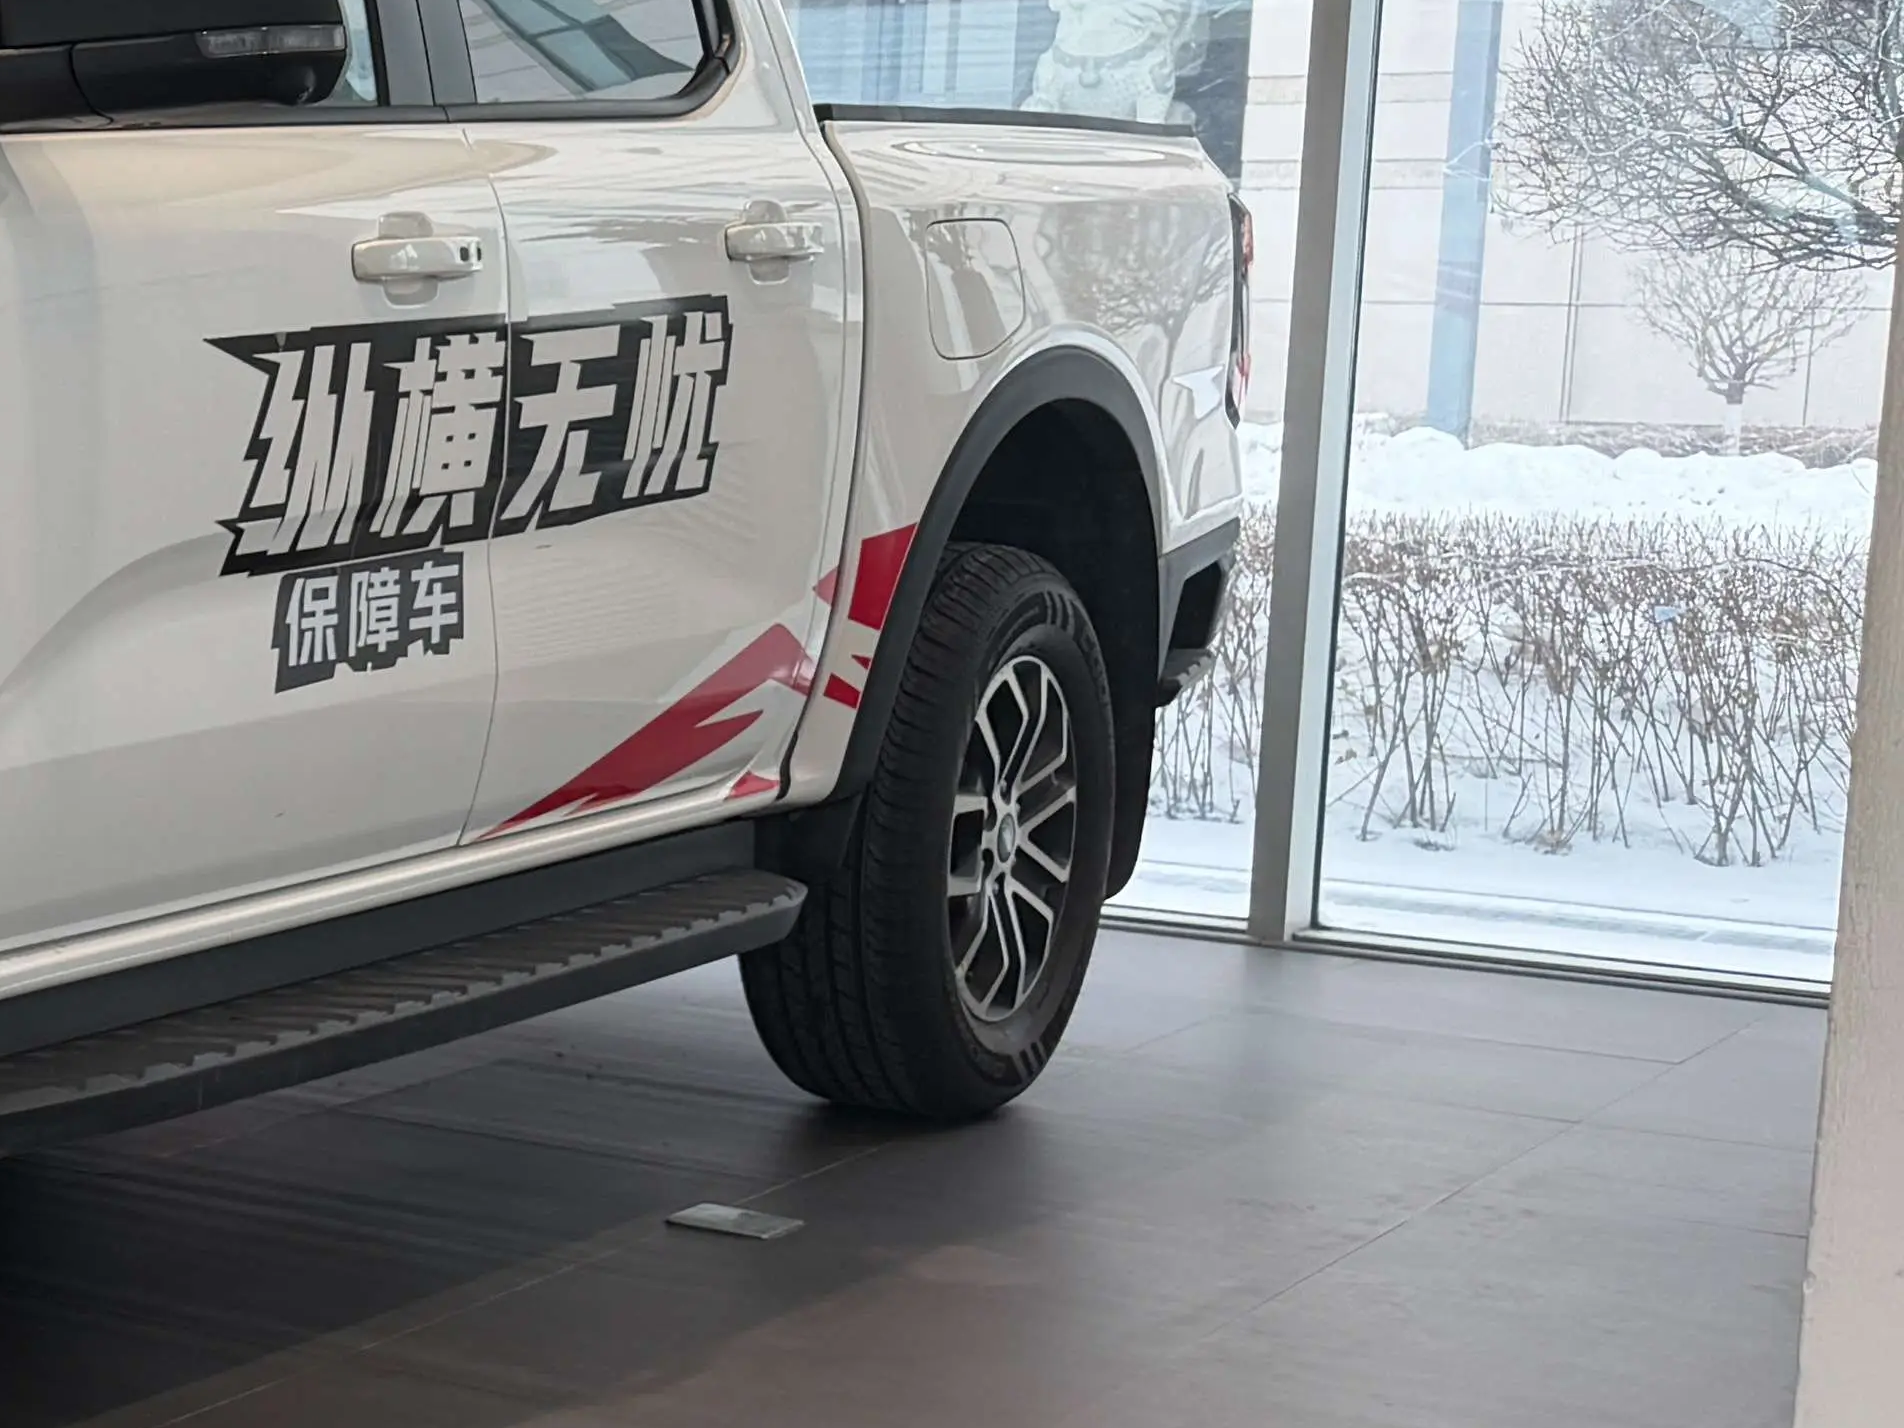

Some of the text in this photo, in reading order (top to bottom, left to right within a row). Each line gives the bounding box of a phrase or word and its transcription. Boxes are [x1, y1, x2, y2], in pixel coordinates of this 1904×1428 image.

[234, 310, 724, 555] 纵横无忧
[283, 561, 462, 667] 保障车
